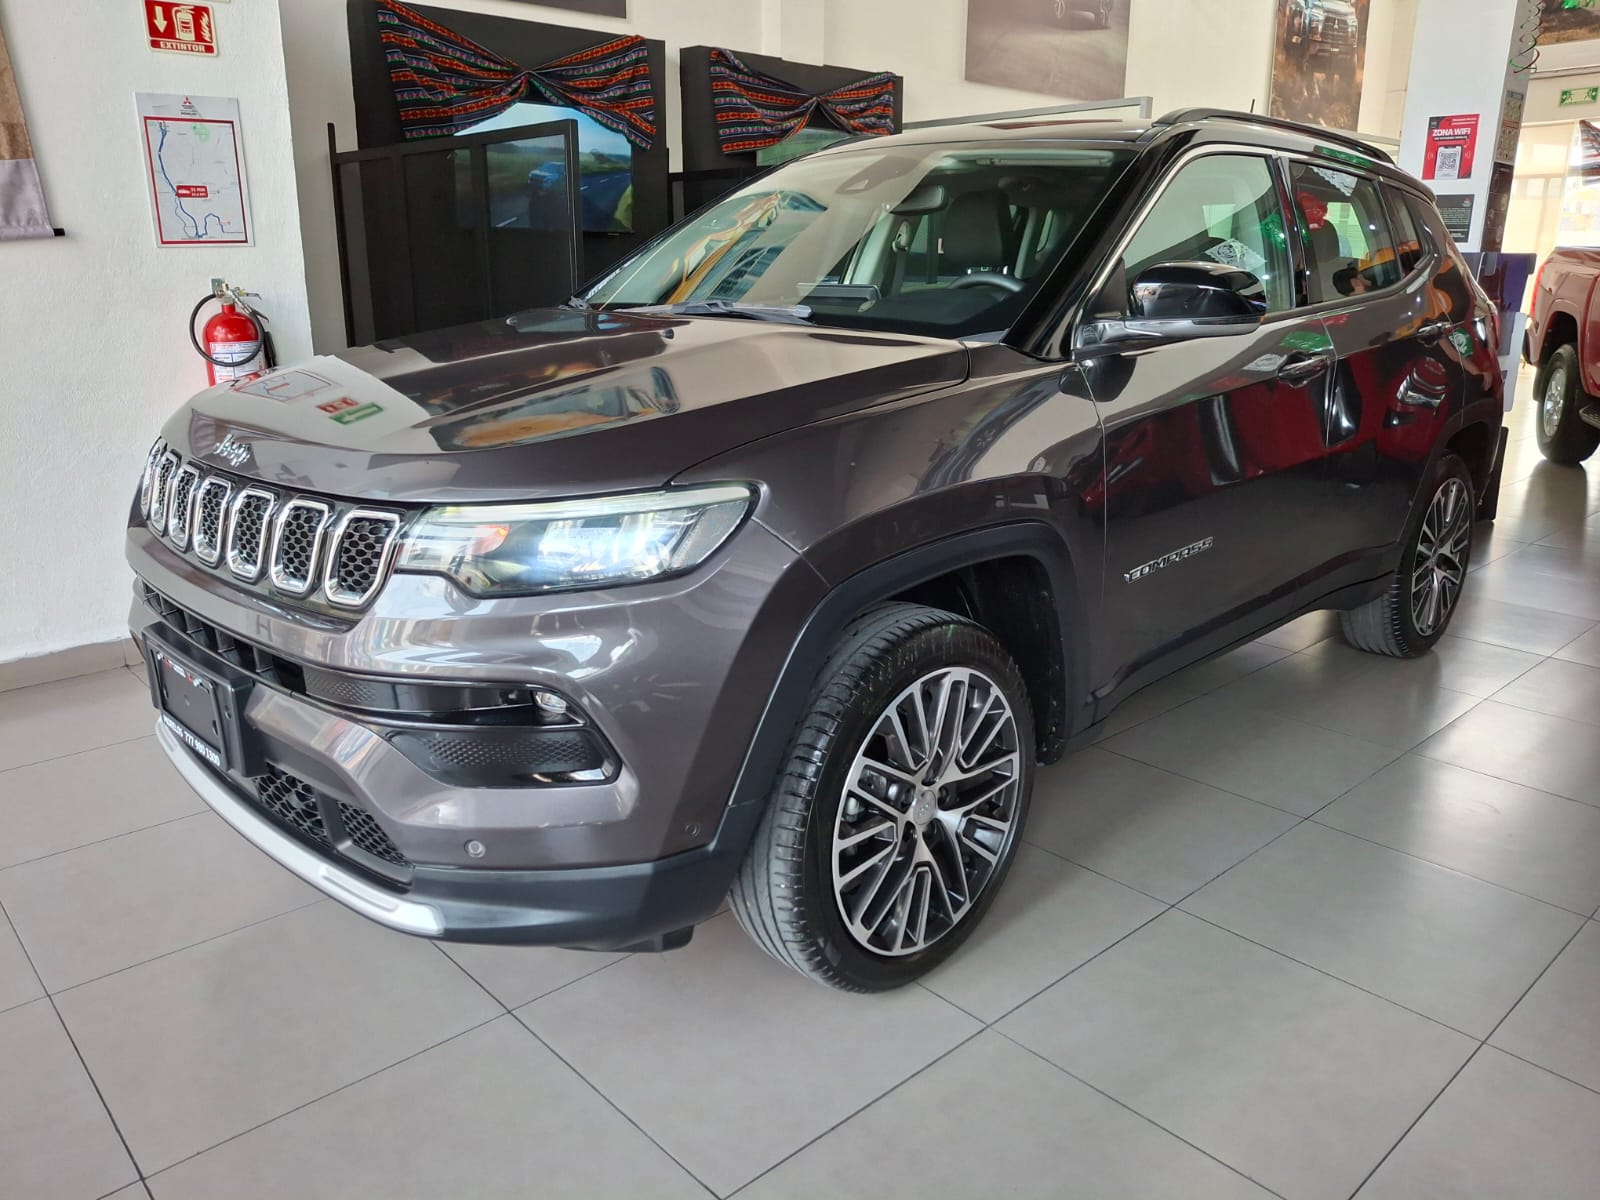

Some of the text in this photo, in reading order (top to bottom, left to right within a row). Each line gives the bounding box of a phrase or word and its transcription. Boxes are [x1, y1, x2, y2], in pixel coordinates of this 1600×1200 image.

[159, 41, 206, 53] EXTINTOR
[1432, 127, 1471, 137] ZONA WIFI
[213, 433, 250, 467] Jeep
[1123, 536, 1213, 584] COMPASS
[184, 731, 194, 747] 777
[205, 748, 221, 767] 1300
